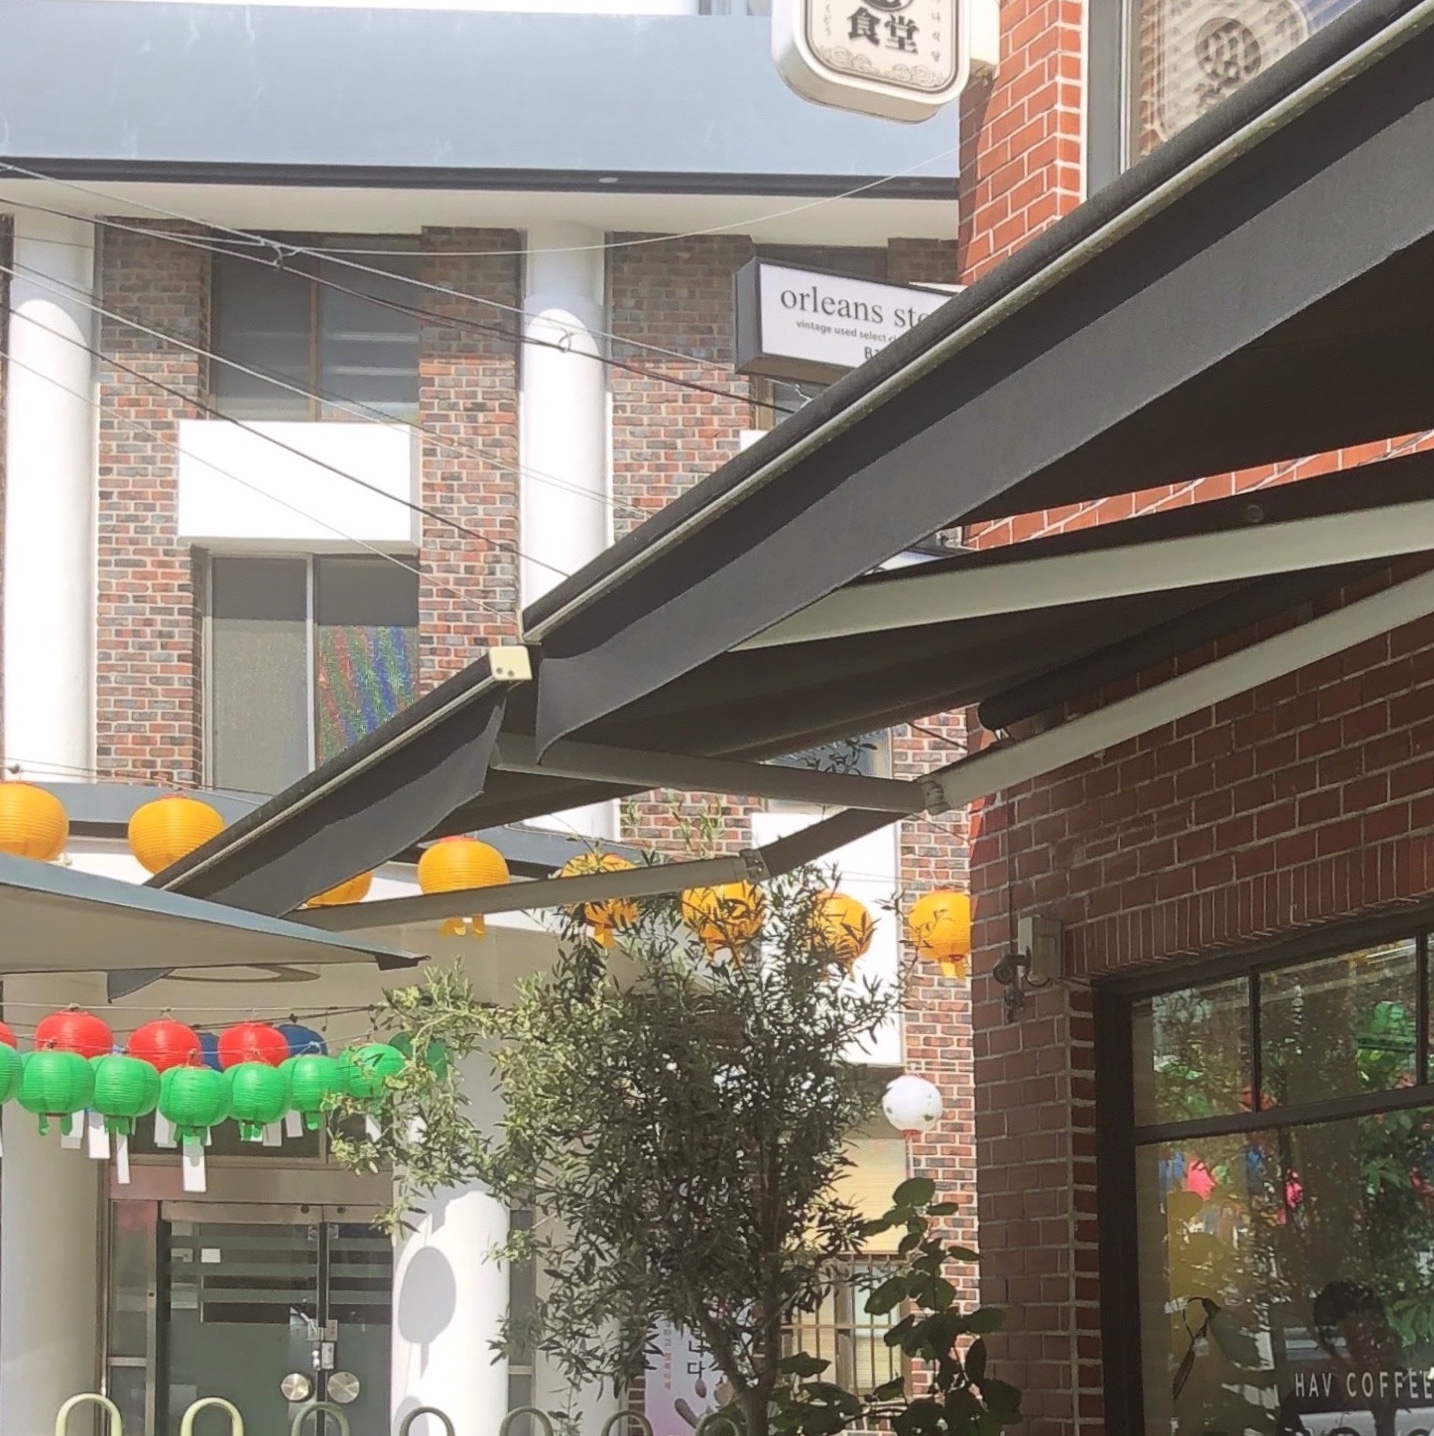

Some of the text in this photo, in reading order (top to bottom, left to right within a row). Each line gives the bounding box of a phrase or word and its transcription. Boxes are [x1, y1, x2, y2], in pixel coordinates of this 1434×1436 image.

[846, 6, 919, 54] 食堂
[780, 286, 884, 324] orleans
[796, 319, 832, 335] vintage
[834, 327, 857, 338] used
[859, 331, 886, 343] select
[1295, 1371, 1433, 1399] HAV COFFEE
